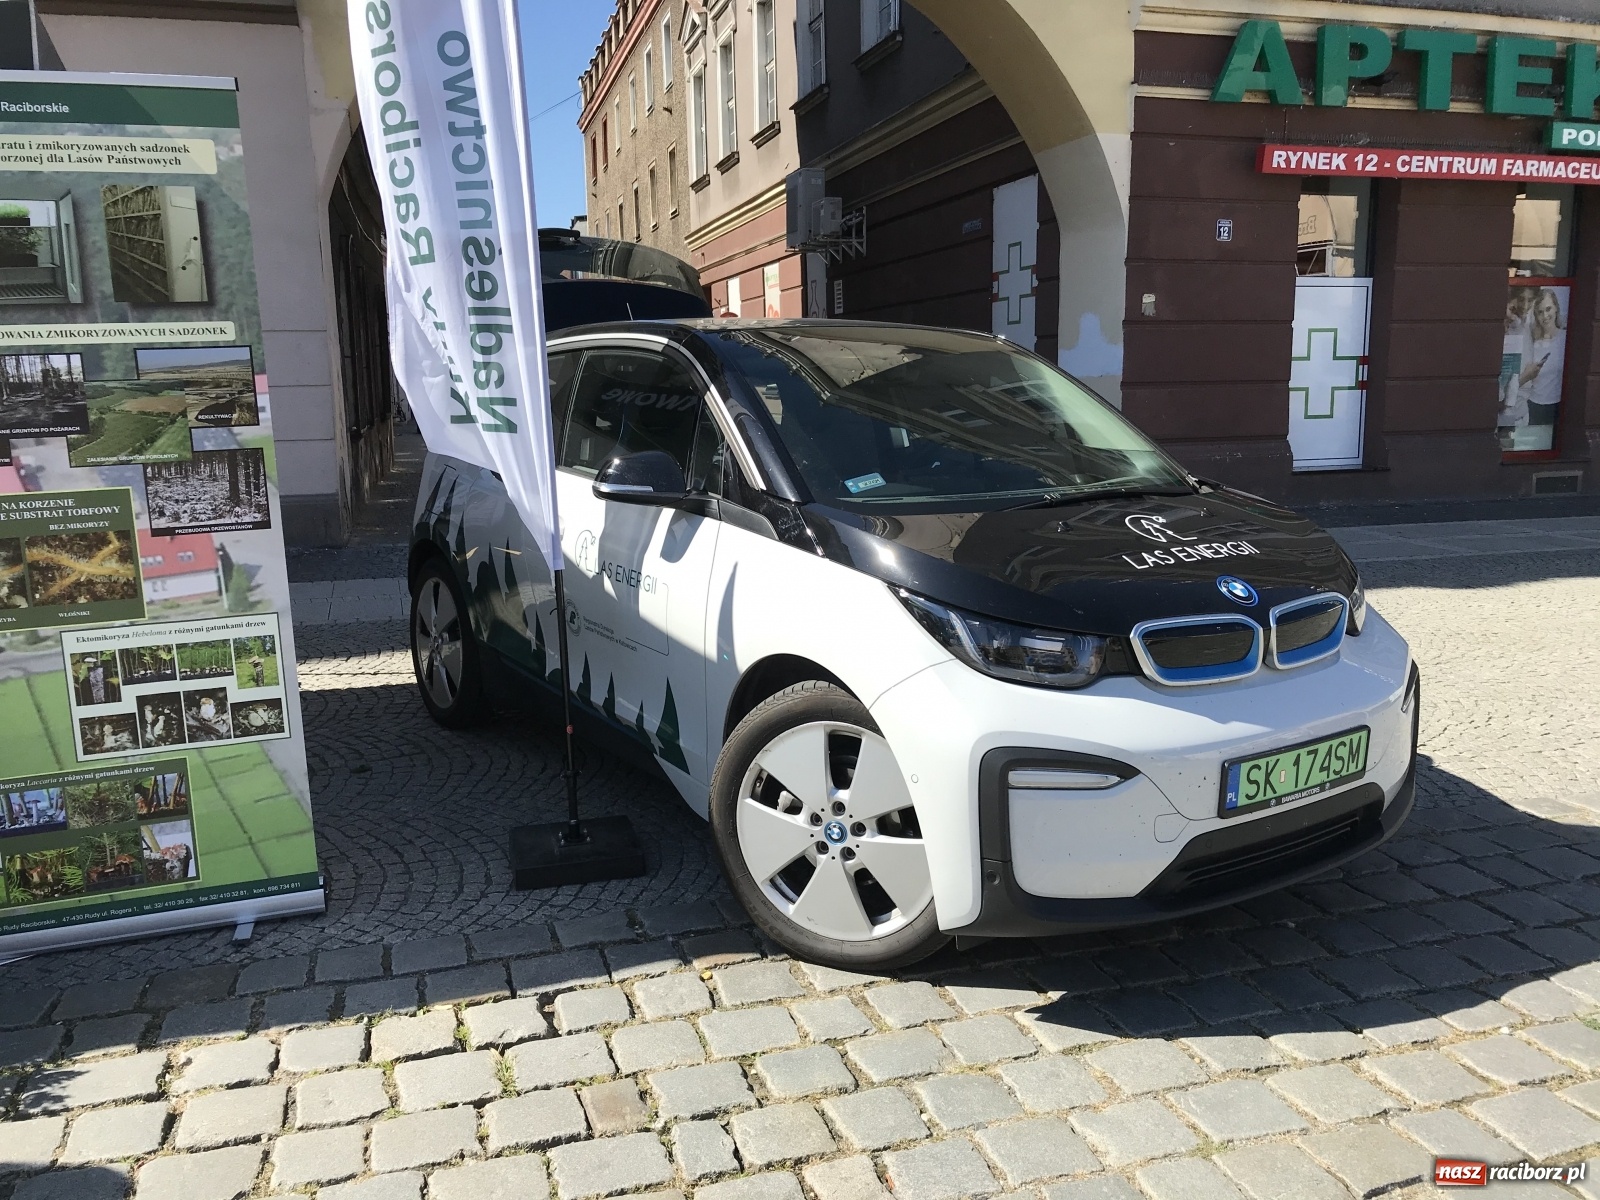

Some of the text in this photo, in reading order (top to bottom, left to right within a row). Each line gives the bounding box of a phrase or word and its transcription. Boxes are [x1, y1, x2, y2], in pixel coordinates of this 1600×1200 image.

[0, 101, 70, 113] Raciborskie
[1562, 128, 1600, 147] PO
[0, 140, 191, 154] ratu i zmikoryzowanych sadzonek
[47, 153, 65, 163] dla
[68, 153, 103, 164] Lasów
[107, 154, 182, 167] Państwowych
[1272, 150, 1348, 171] RYNEK
[1354, 153, 1379, 172] 12
[1396, 155, 1498, 175] CENTRUM
[1219, 226, 1229, 237] 12
[46, 328, 166, 338] ZMIKORYZOWANYCH
[169, 326, 228, 336] SADZONEK
[1, 499, 76, 511] NA KORZENIE
[9, 509, 64, 520] SUBSTRAT
[66, 505, 121, 516] TORFOWY
[49, 520, 110, 531] BEZ MIKORYZY
[1122, 540, 1260, 570] LAS ENERGII
[594, 557, 658, 596] LAS ENERGII
[76, 634, 130, 643] Ektomikoryza
[132, 629, 167, 638] Hebeloma
[174, 625, 204, 635] różnymi
[205, 621, 244, 632] gatunkami
[245, 620, 267, 628] drzew
[1245, 735, 1362, 801] SK 174SM
[0, 781, 25, 791] koryza
[64, 772, 94, 783] różnymi
[95, 767, 133, 779] gatunkami
[134, 765, 155, 774] drzew
[1227, 792, 1237, 803] PL
[3, 924, 19, 932] Rudy
[84, 911, 101, 921] Rudy
